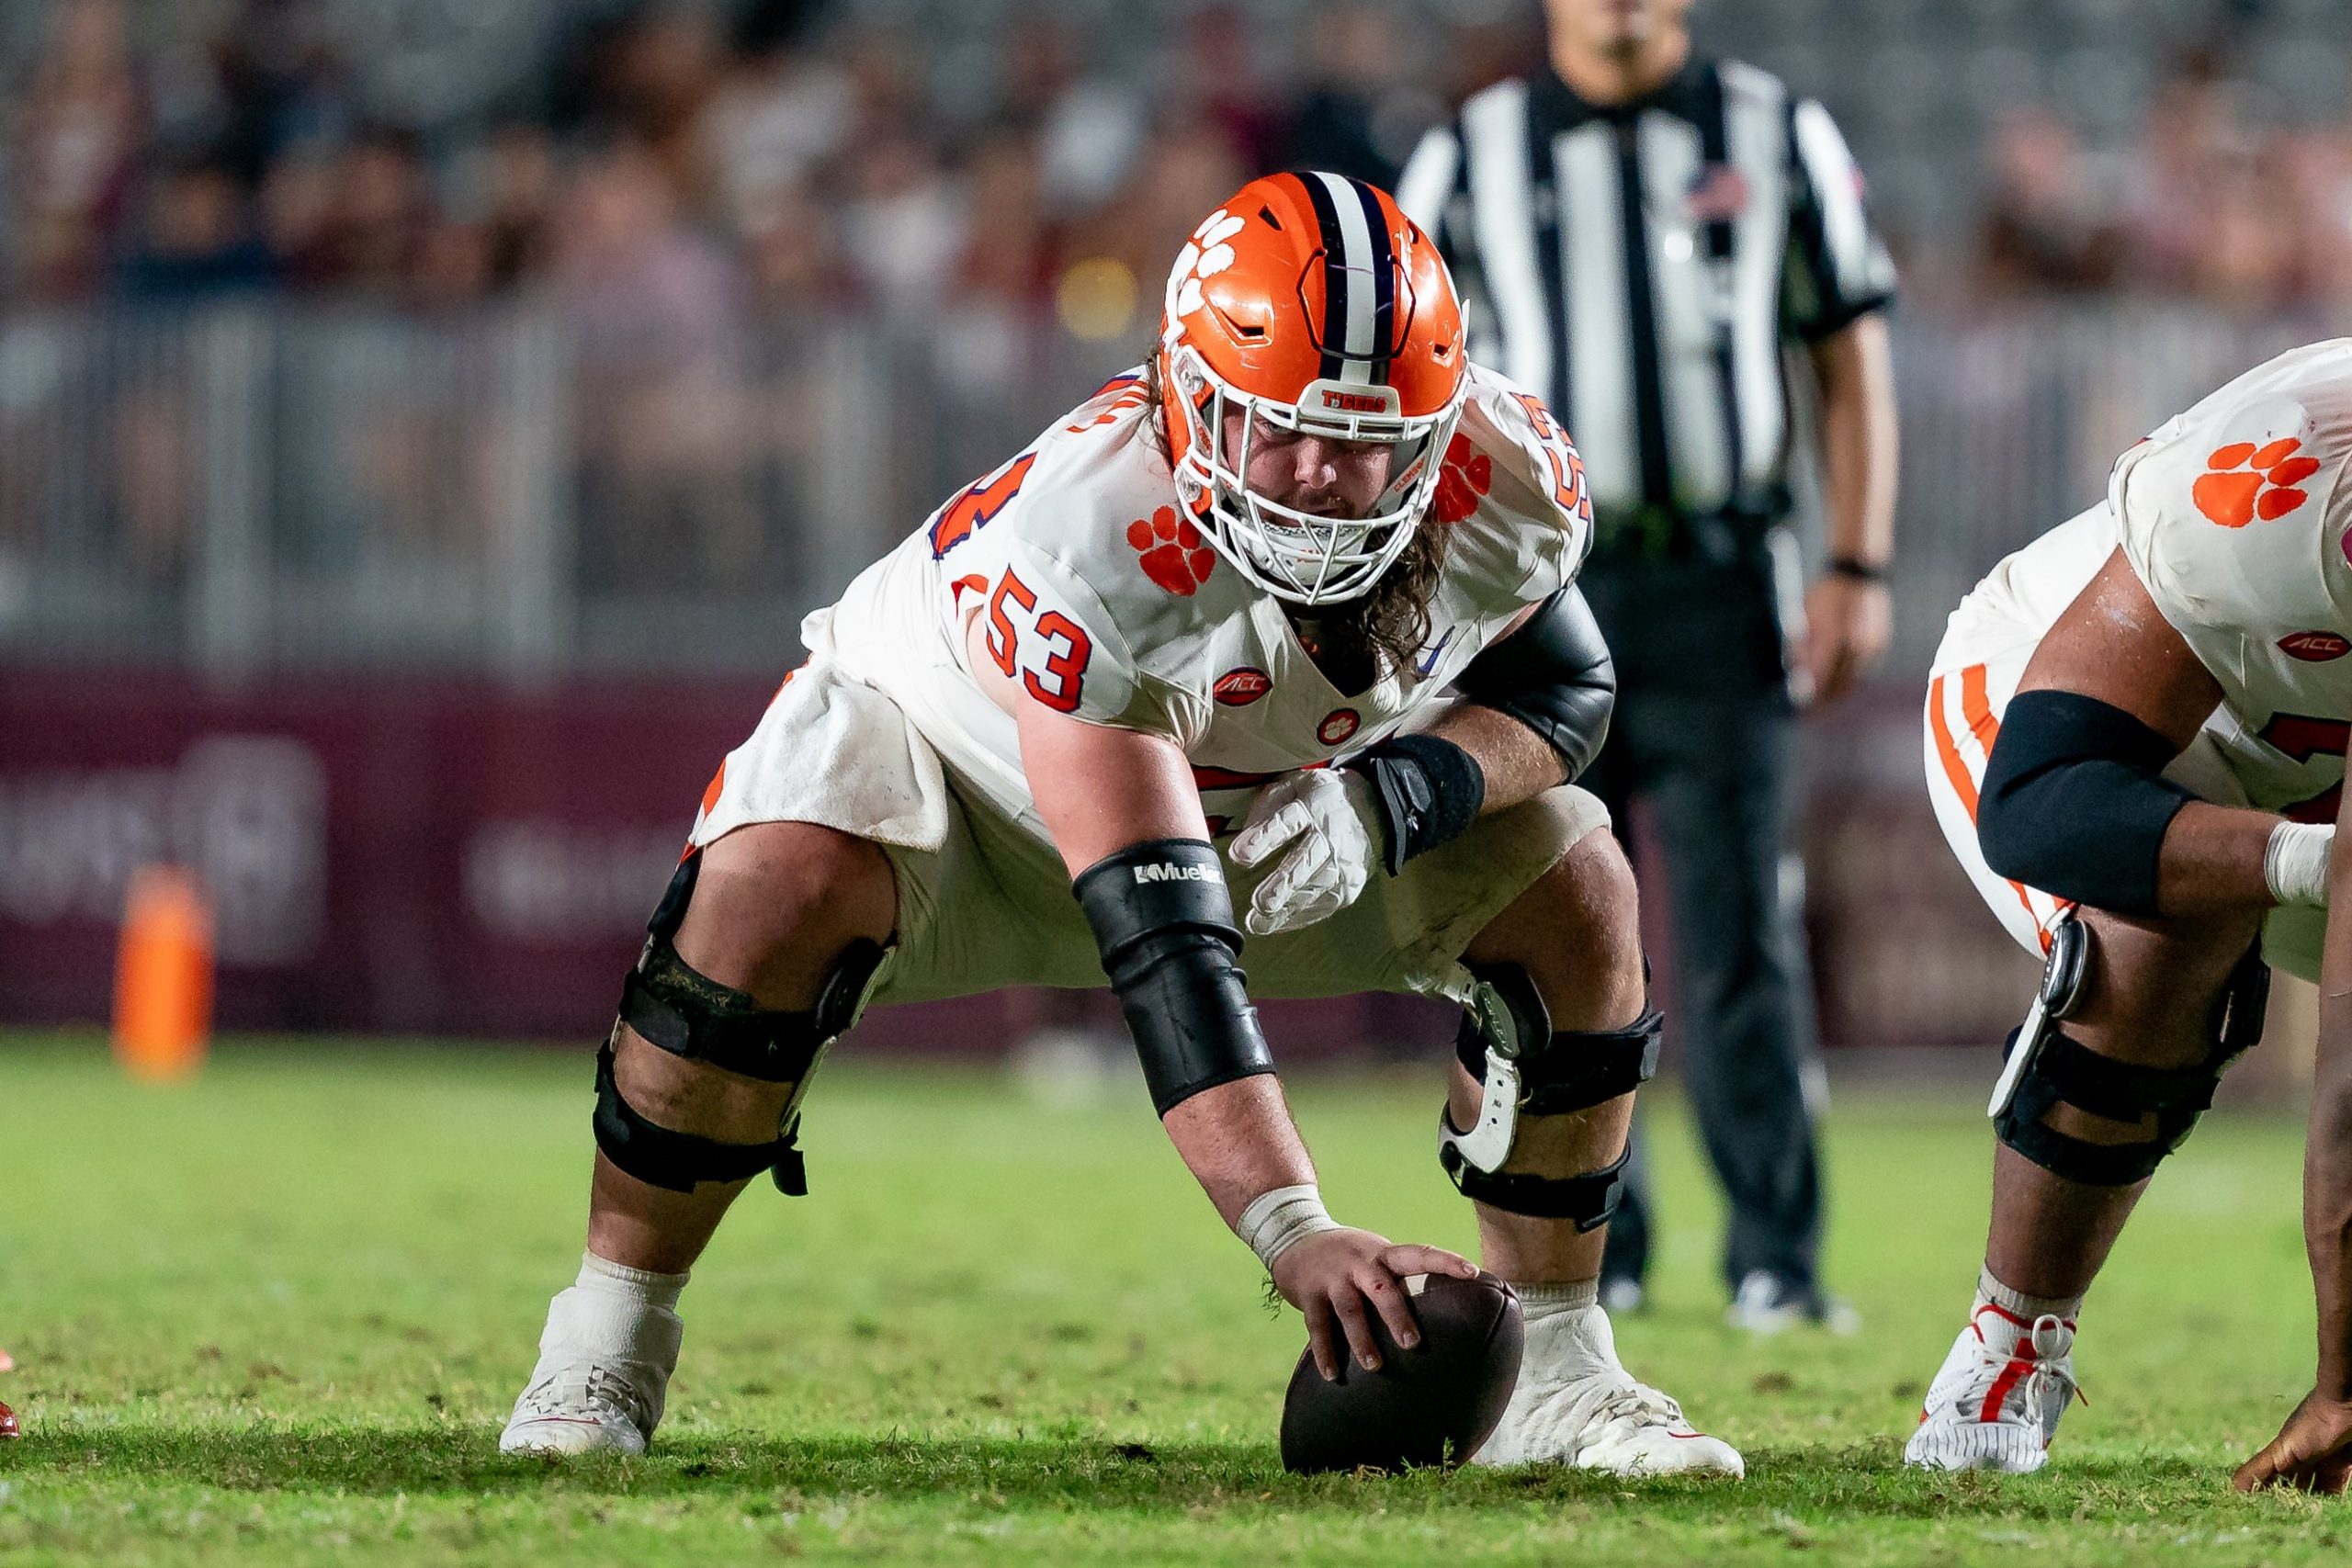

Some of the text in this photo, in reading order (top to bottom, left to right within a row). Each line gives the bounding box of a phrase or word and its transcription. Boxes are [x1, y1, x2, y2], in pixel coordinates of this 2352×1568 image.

[986, 562, 1092, 714] 53
[2288, 637, 2343, 651] ACC
[1218, 675, 1267, 692] ACC
